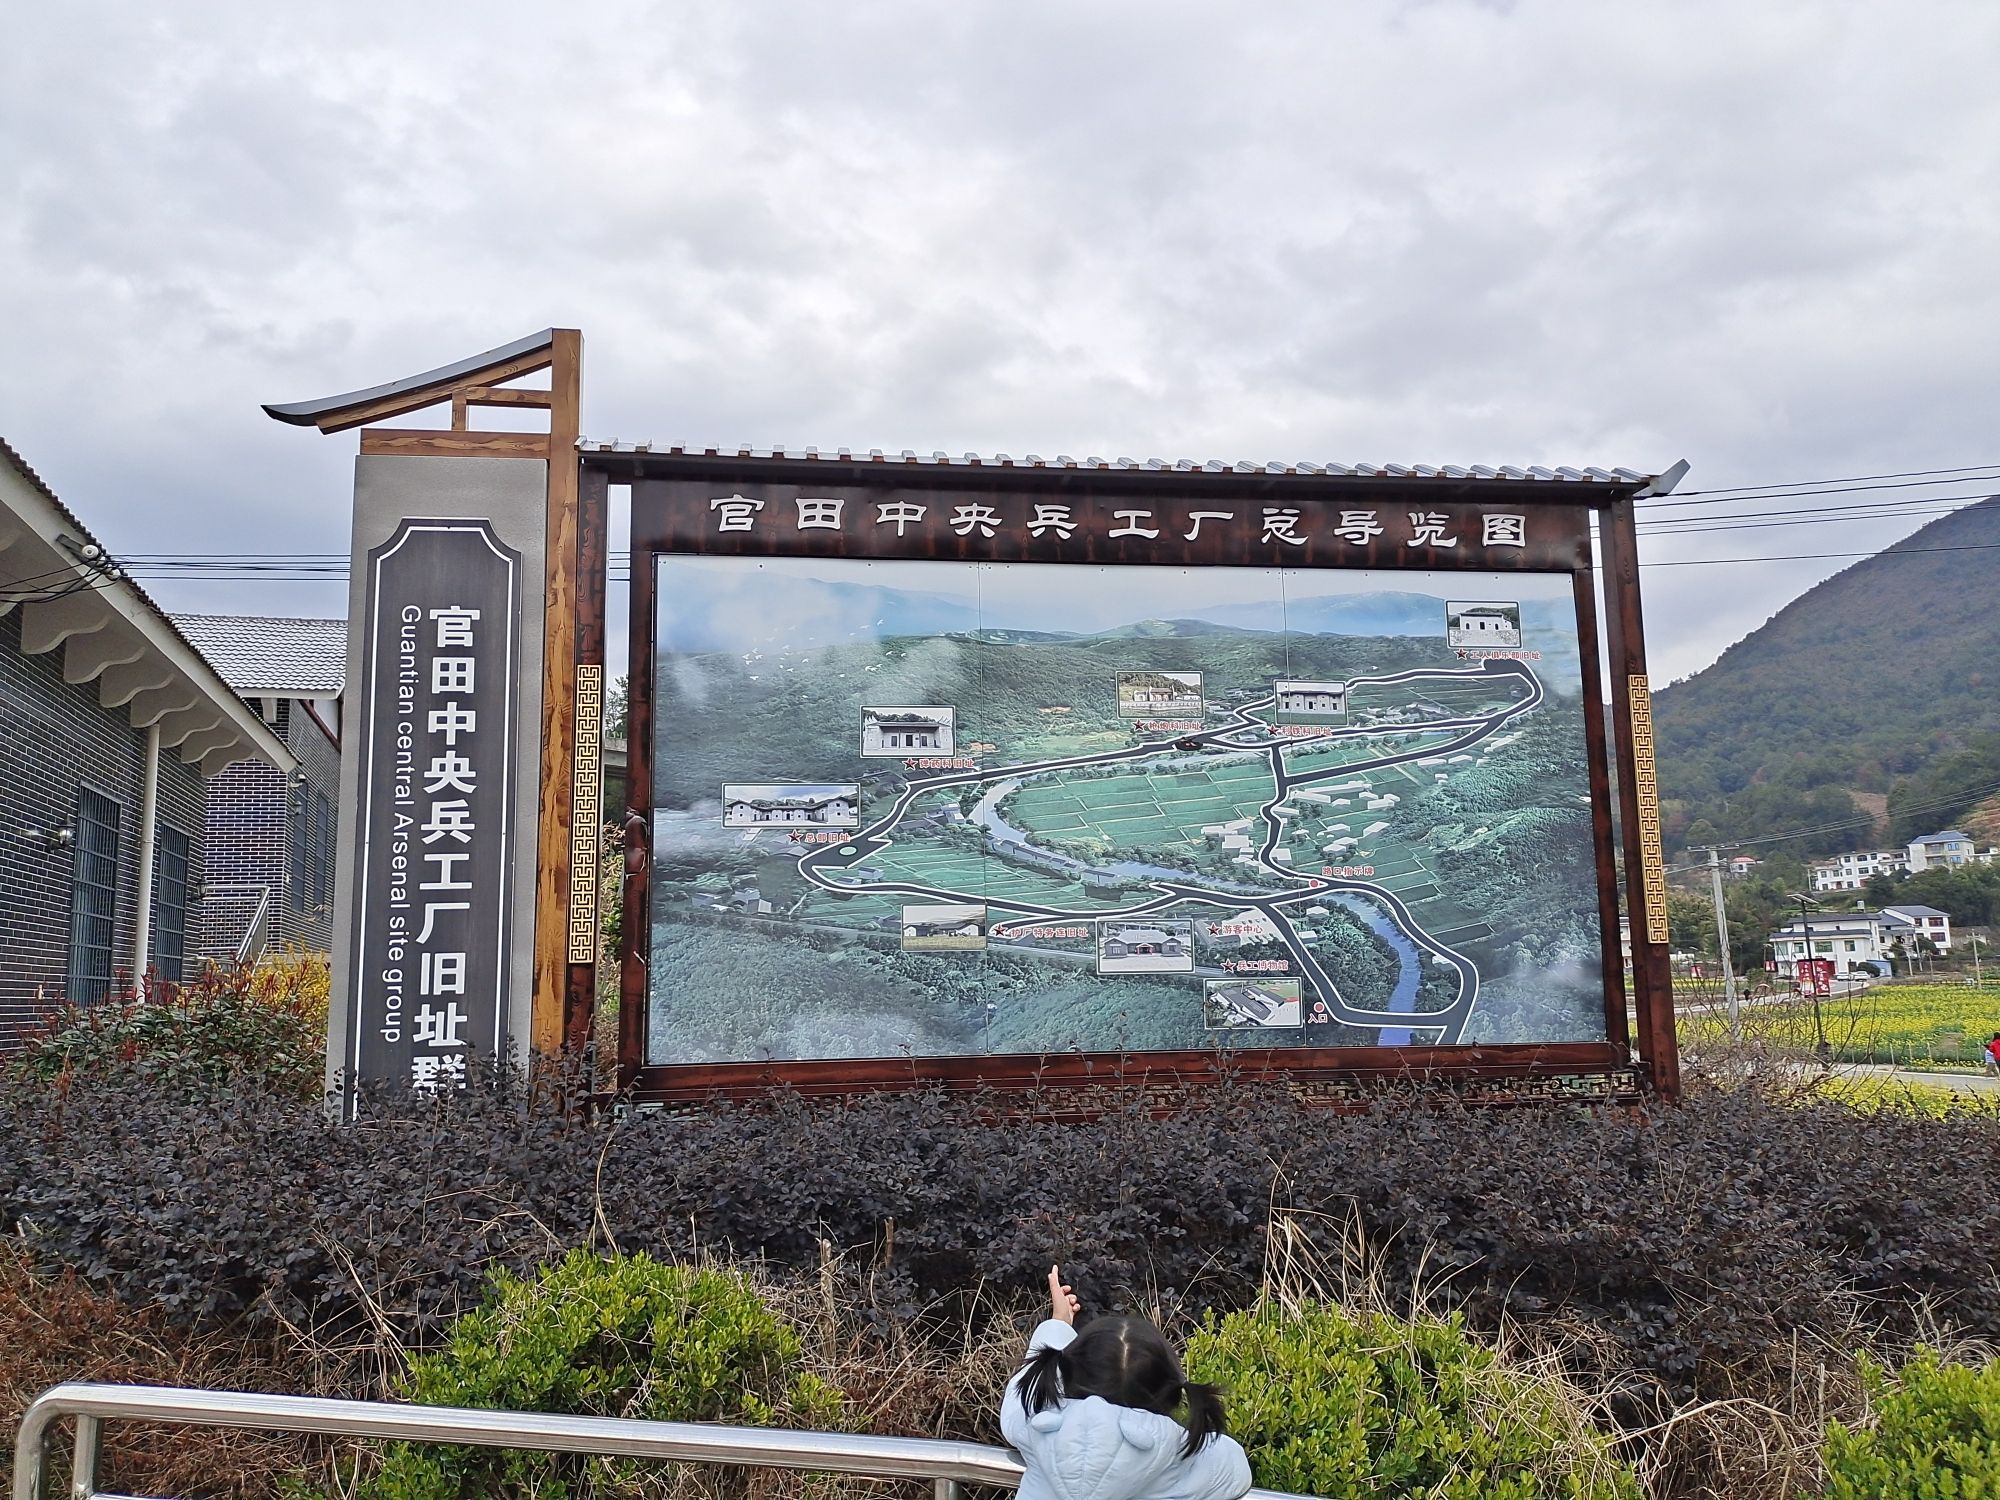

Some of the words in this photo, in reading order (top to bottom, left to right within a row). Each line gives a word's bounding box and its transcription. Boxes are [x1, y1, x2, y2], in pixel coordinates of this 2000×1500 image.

[710, 493, 1527, 549] 官田中央兵工厂总导览图
[398, 604, 422, 714] Guantian
[394, 721, 416, 805] central
[390, 812, 414, 908] Arsenal
[805, 833, 851, 843] 总部旧址
[1322, 866, 1375, 876] 路口指示牌
[388, 916, 410, 961] site
[1222, 924, 1263, 934] 游客中心
[1237, 960, 1289, 971] 兵工博物馆
[380, 968, 403, 1043] group
[1308, 1013, 1328, 1024] 入口
